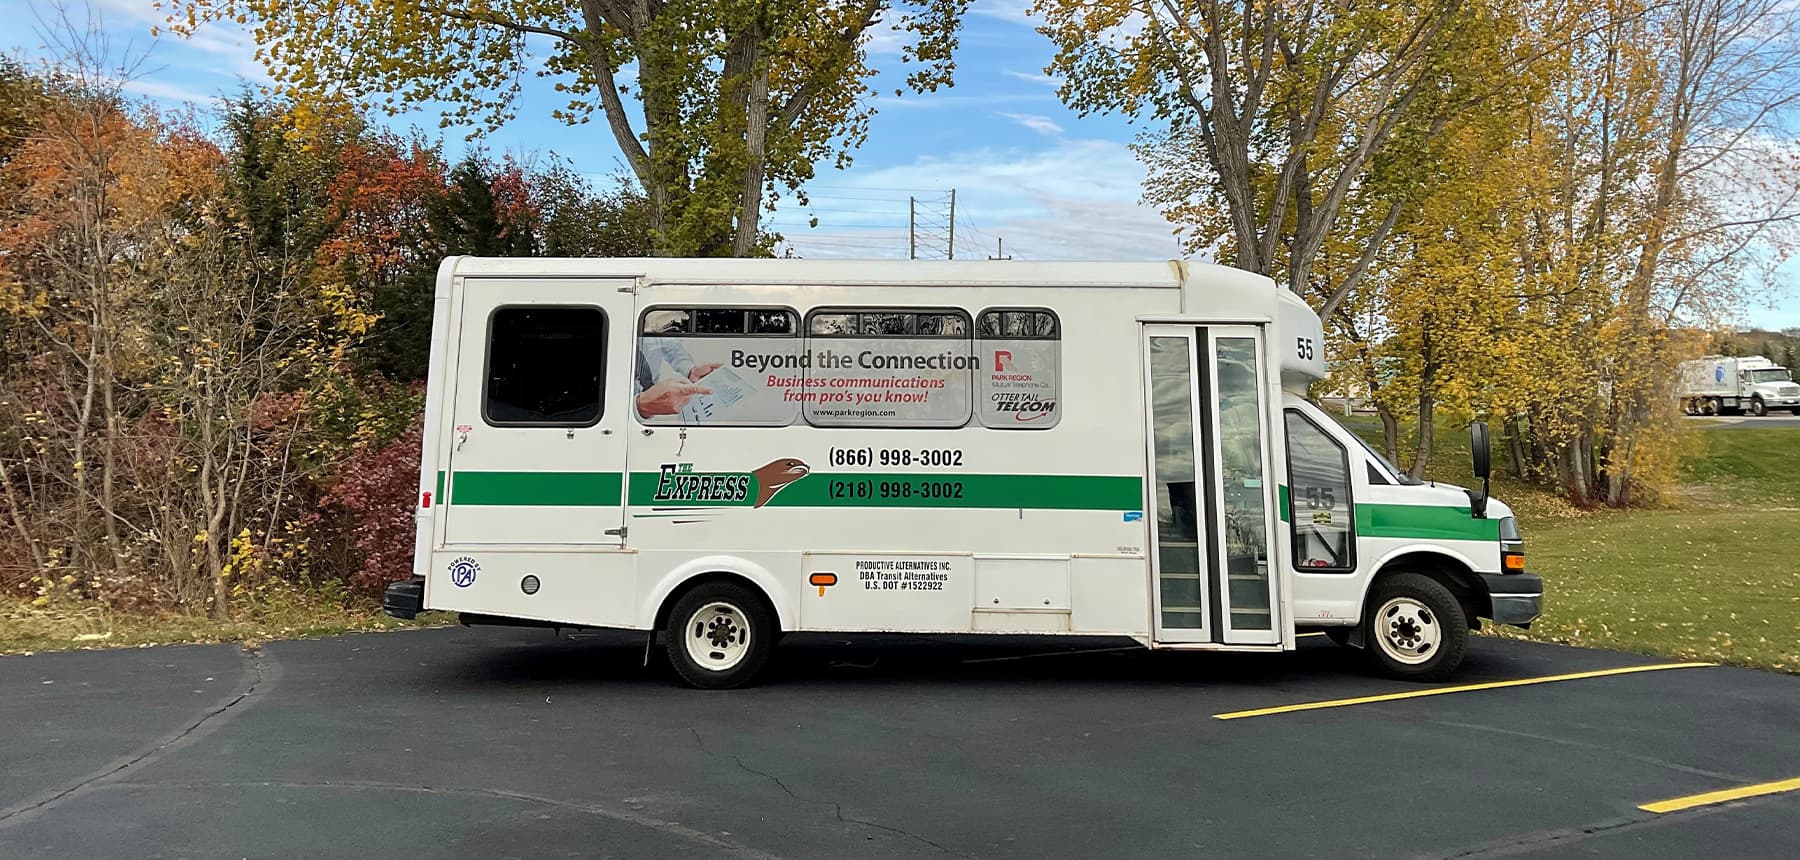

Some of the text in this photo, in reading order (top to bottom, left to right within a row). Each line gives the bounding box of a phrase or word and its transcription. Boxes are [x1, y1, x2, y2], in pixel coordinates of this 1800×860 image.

[1297, 337, 1313, 360] 55
[731, 350, 980, 373] Beyond the Connection
[767, 375, 945, 389] Business communications
[783, 389, 928, 405] from pro's you know!
[992, 393, 1038, 401] OTTER TAIL
[813, 409, 896, 417] www.parkregion.com
[996, 401, 1055, 412] TELCOM
[829, 447, 963, 467] (866) 998-3002
[678, 463, 693, 472] THE
[829, 479, 963, 499] (218) 998-3002
[1306, 487, 1335, 510] 55
[447, 556, 476, 571] POWERED
[856, 560, 952, 571] PRODUCTIVE ALTERNATIVES INC.
[859, 571, 948, 581] DBA Transit Alternatives
[865, 581, 943, 590] U.S. DOT #1522922
